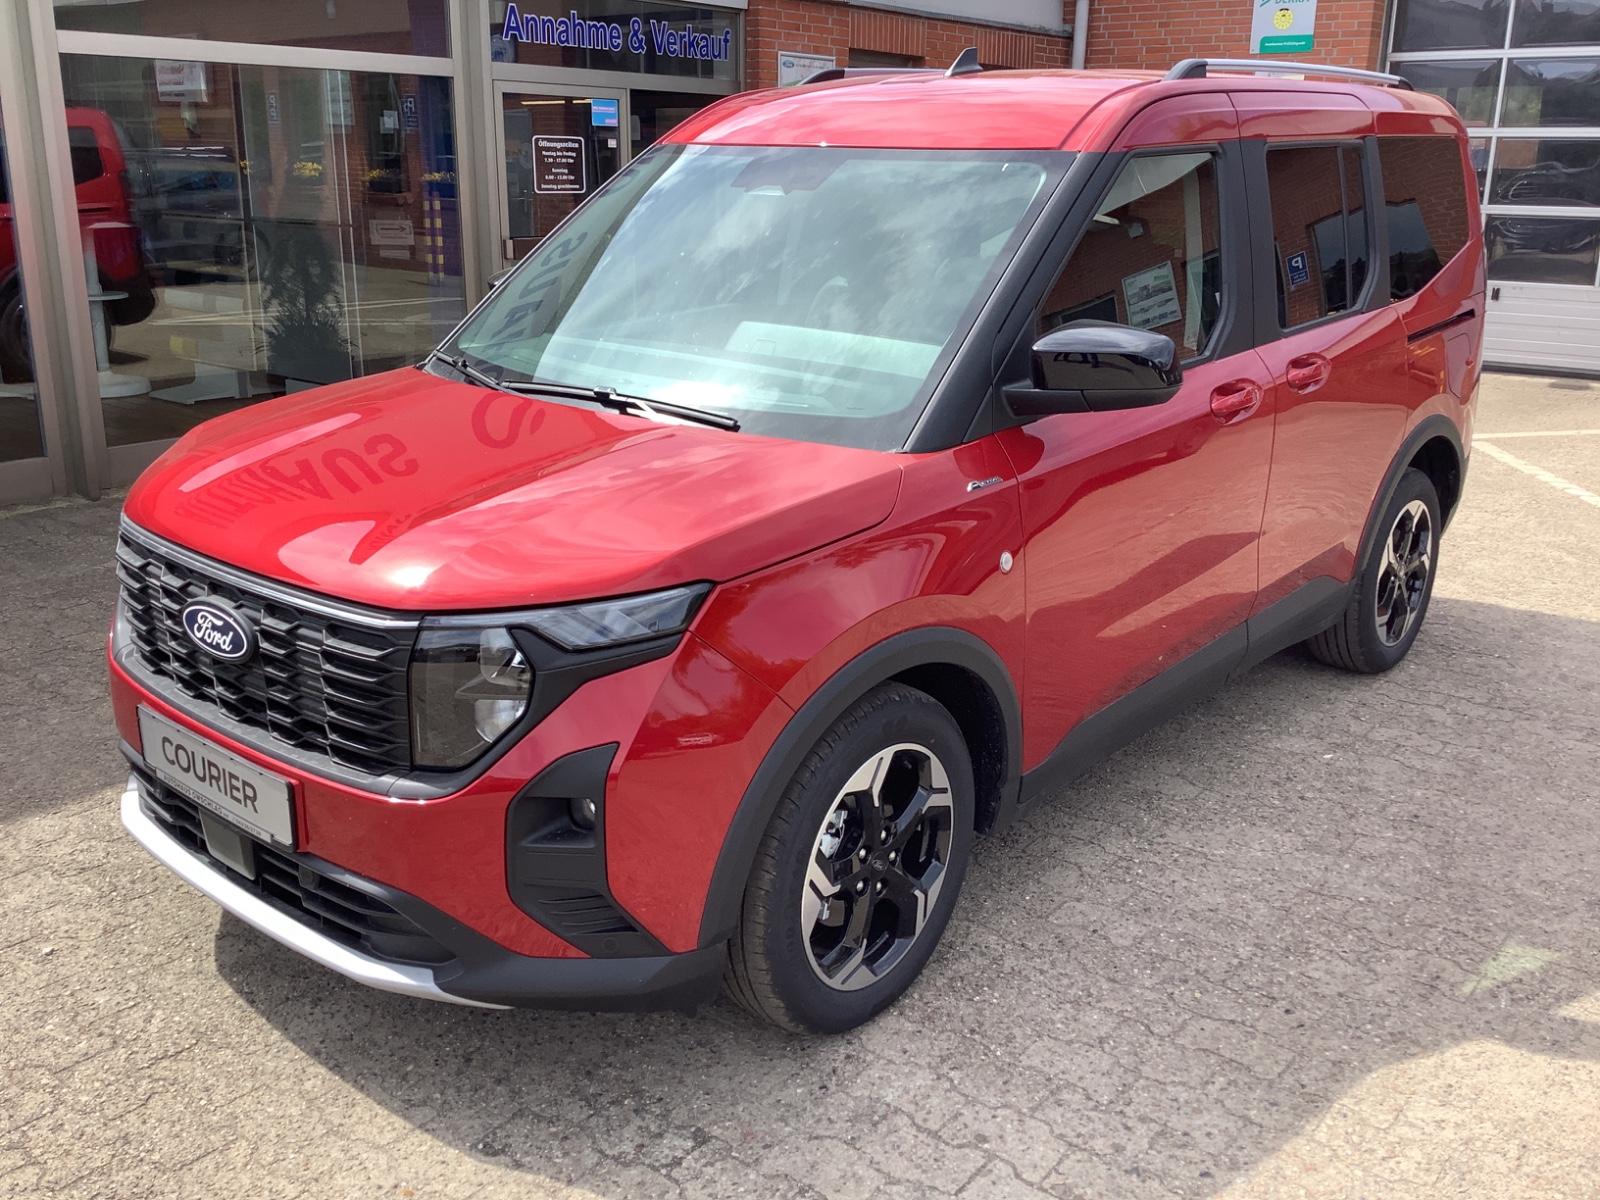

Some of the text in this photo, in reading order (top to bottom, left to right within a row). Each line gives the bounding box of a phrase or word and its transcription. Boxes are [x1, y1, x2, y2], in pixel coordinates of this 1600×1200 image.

[503, 3, 731, 61] Annahme & Verkauf
[538, 139, 579, 149] Öffnungszeiten
[193, 611, 234, 651] Ford
[161, 736, 260, 814] COURIER
